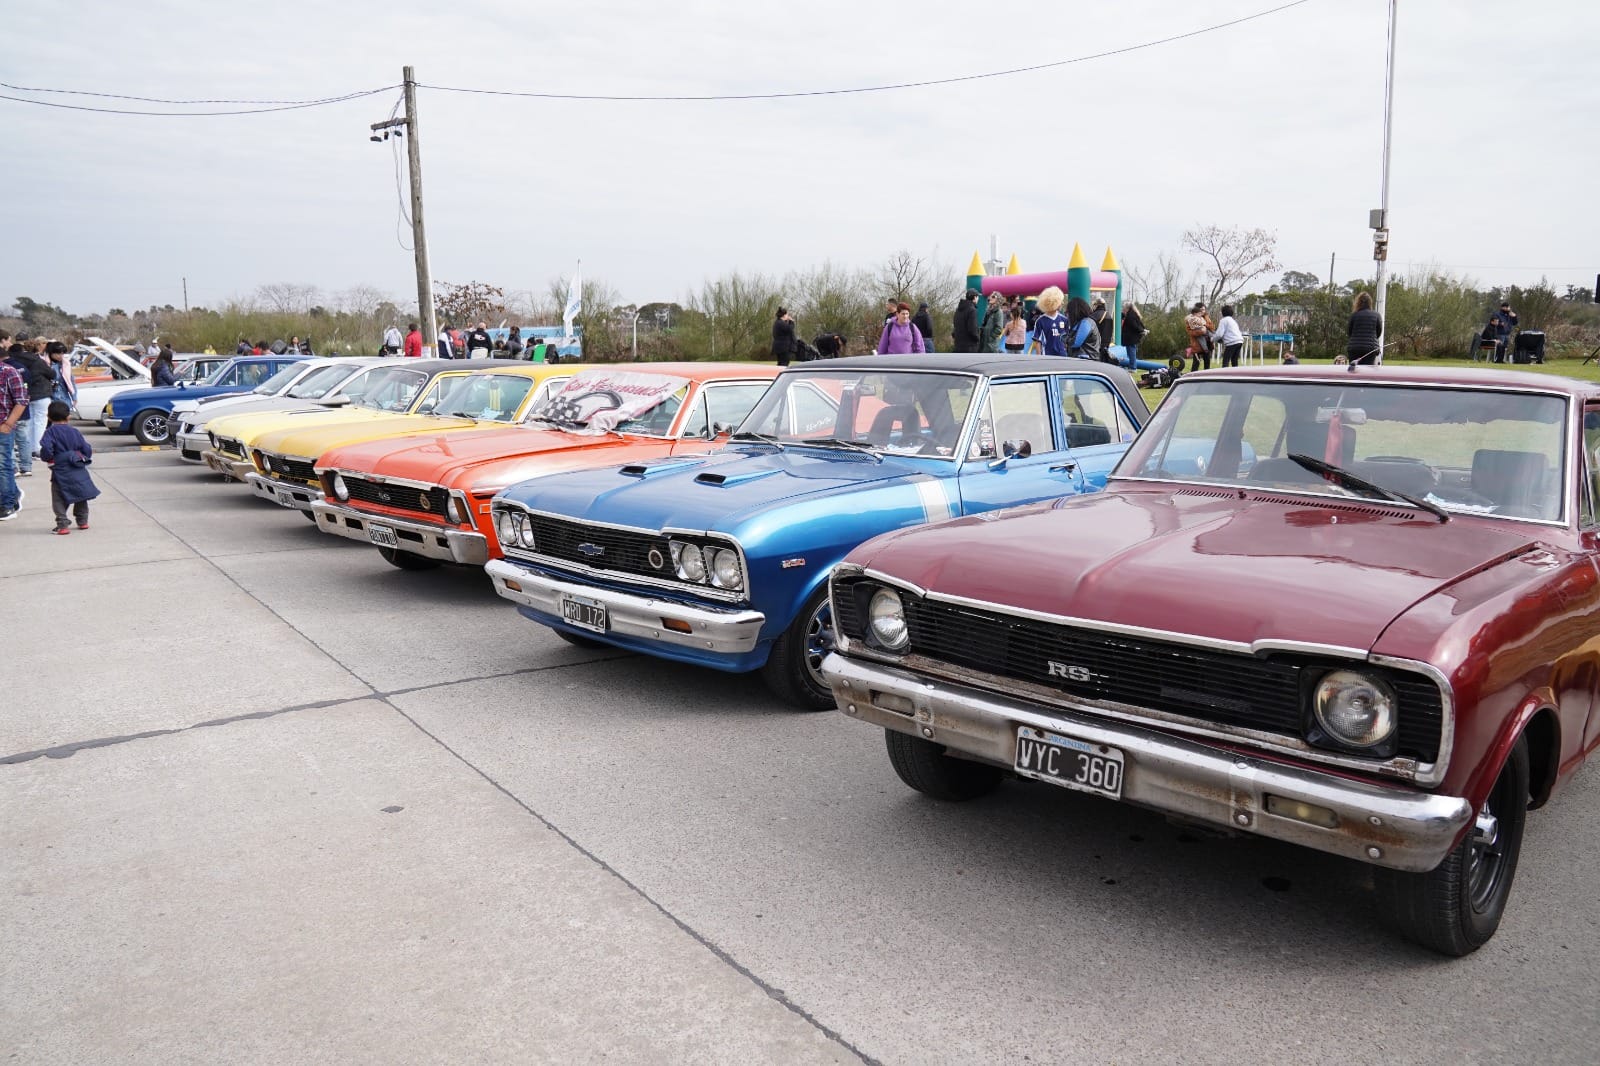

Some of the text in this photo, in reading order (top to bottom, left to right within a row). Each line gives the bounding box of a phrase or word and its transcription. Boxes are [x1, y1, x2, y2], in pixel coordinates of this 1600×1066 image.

[586, 606, 604, 628] 172
[1047, 660, 1090, 682] RS
[1048, 735, 1092, 753] ARGENTINA
[1020, 739, 1119, 790] VYC 360
